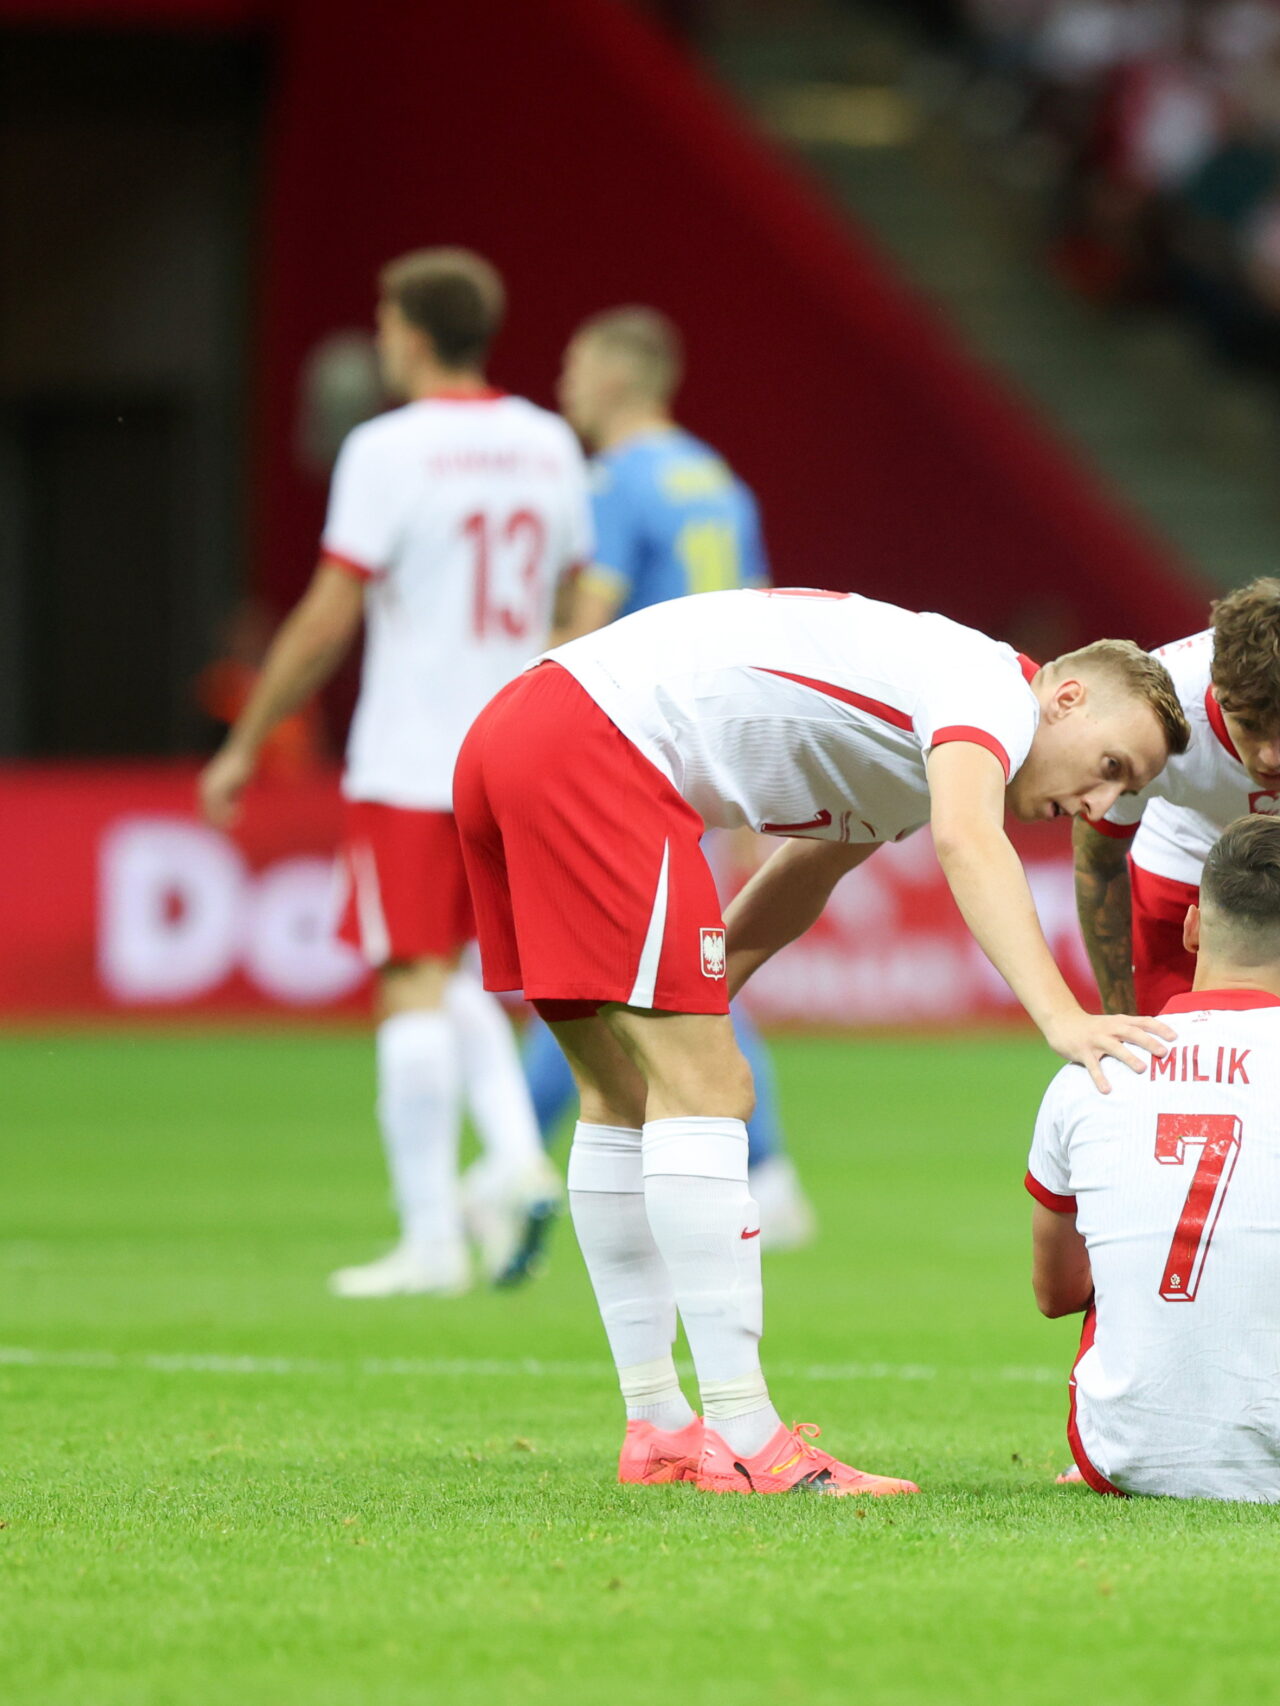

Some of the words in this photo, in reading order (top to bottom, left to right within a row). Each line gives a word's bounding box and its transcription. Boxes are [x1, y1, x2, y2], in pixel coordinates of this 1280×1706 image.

[460, 507, 549, 641] 13
[1150, 1044, 1252, 1085] MILIK
[1154, 1113, 1244, 1303] 7
